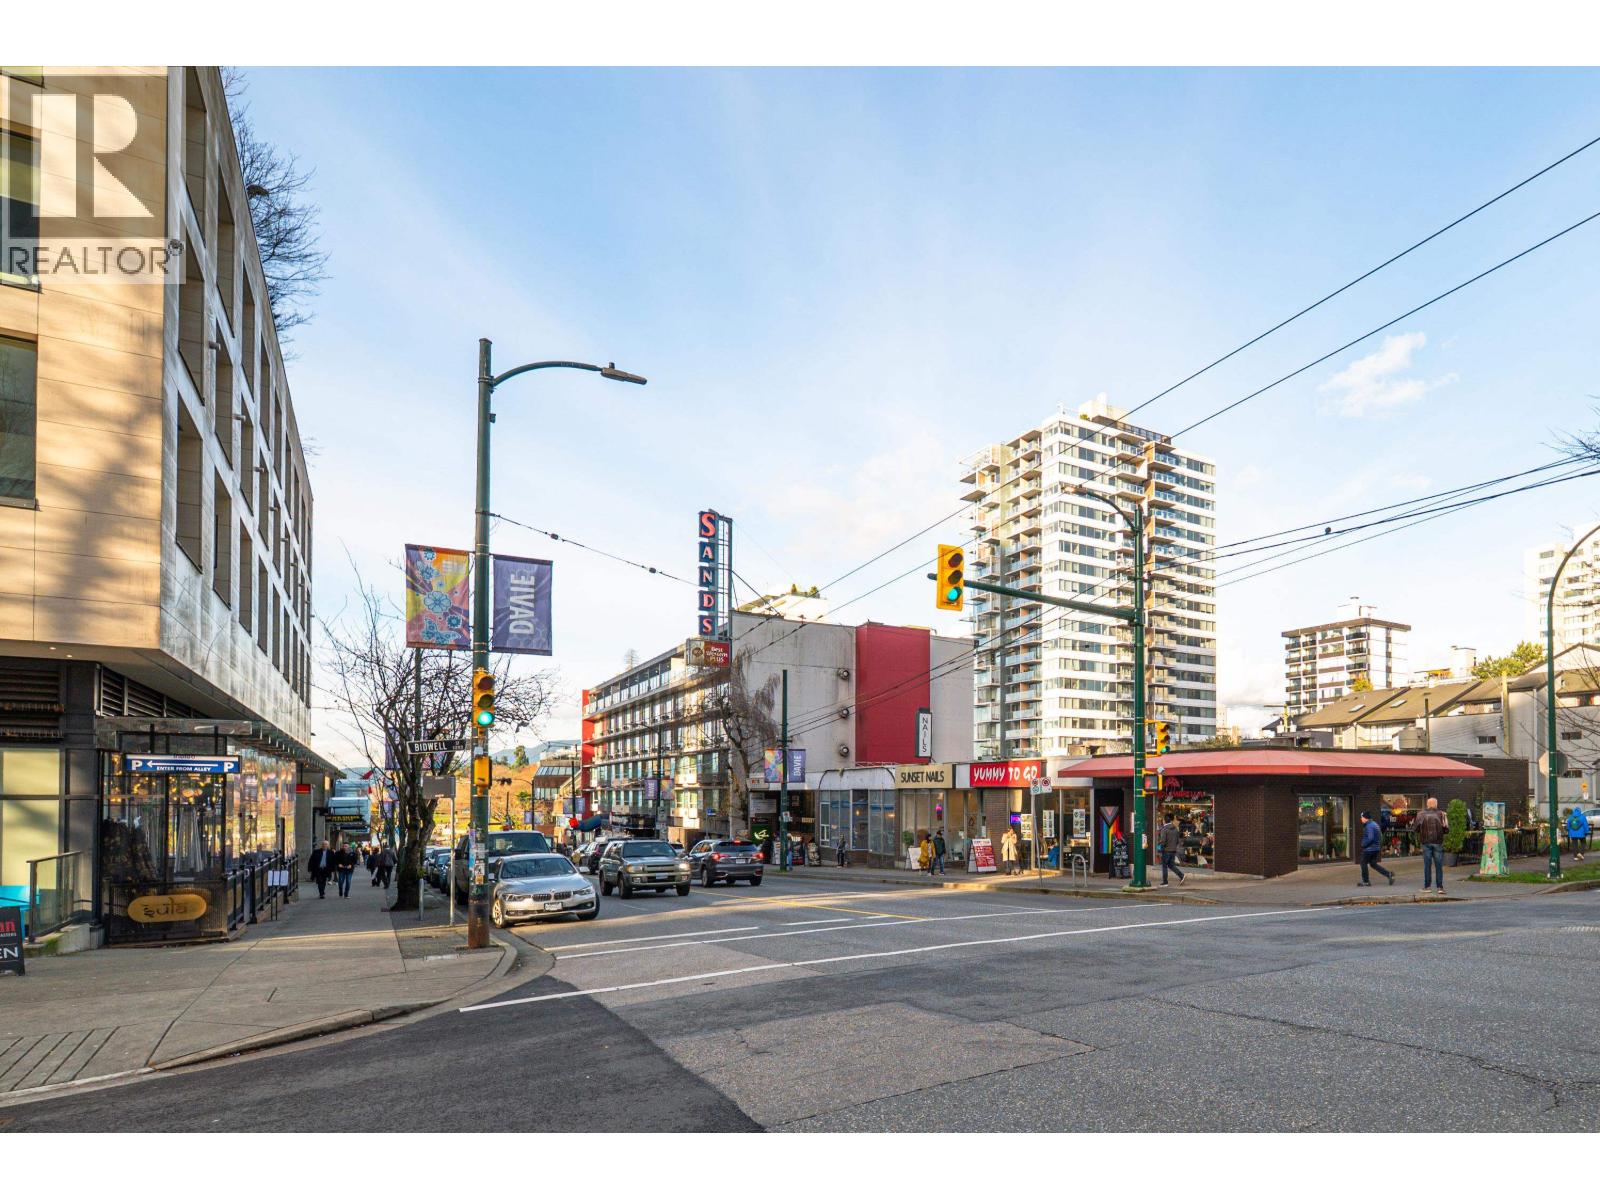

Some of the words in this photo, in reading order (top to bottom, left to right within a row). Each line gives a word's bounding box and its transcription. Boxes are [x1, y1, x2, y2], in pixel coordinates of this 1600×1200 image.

[701, 512, 716, 634] SANDS
[508, 573, 536, 635] DAVIE
[921, 717, 929, 753] NAILS
[414, 742, 448, 752] BIDWELL
[131, 759, 143, 771] P
[223, 761, 235, 773] P
[793, 755, 802, 777] DAVIE
[900, 771, 925, 783] SUNSET
[925, 770, 945, 782] NAILS
[973, 767, 1006, 782] YUMMY
[1007, 766, 1020, 781] TO
[1023, 765, 1038, 780] GO
[0, 946, 19, 960] N
